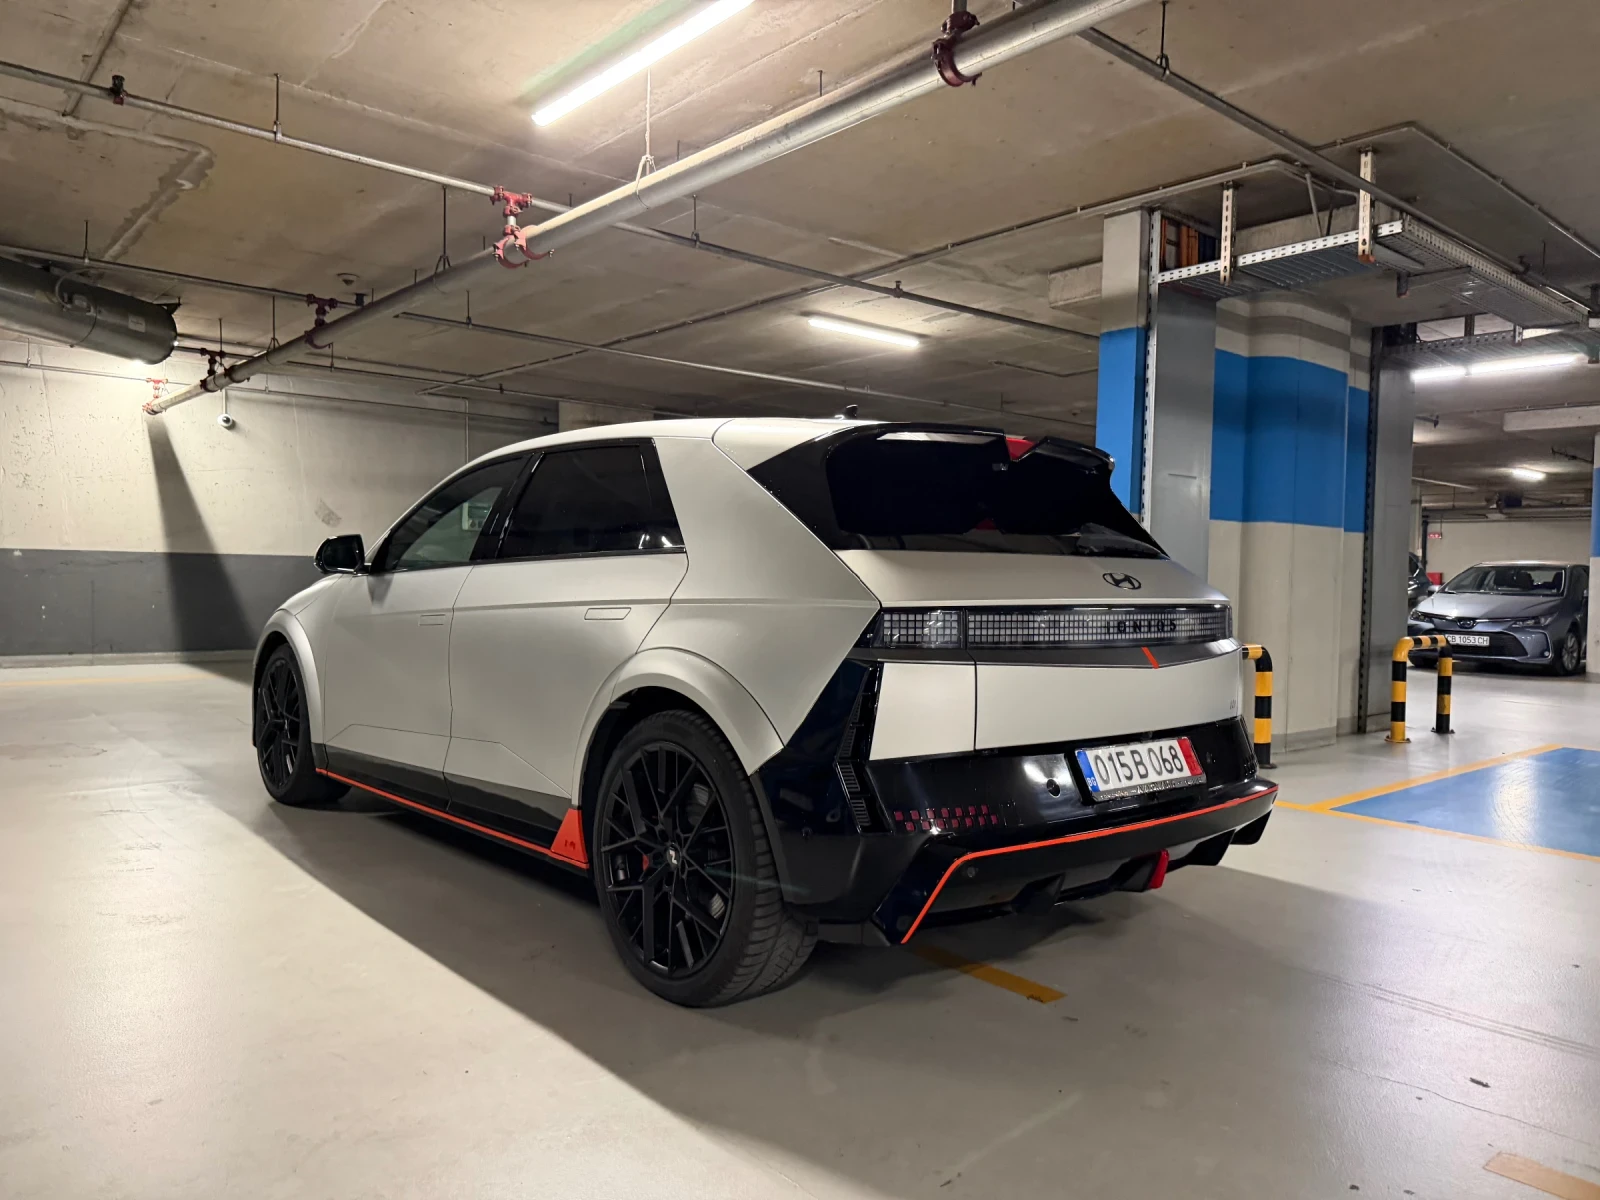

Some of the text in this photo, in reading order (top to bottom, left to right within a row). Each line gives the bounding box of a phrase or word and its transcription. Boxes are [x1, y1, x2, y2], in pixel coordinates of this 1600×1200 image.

[1458, 636, 1477, 644] 1053
[1477, 637, 1489, 645] CH
[1086, 777, 1097, 787] BG
